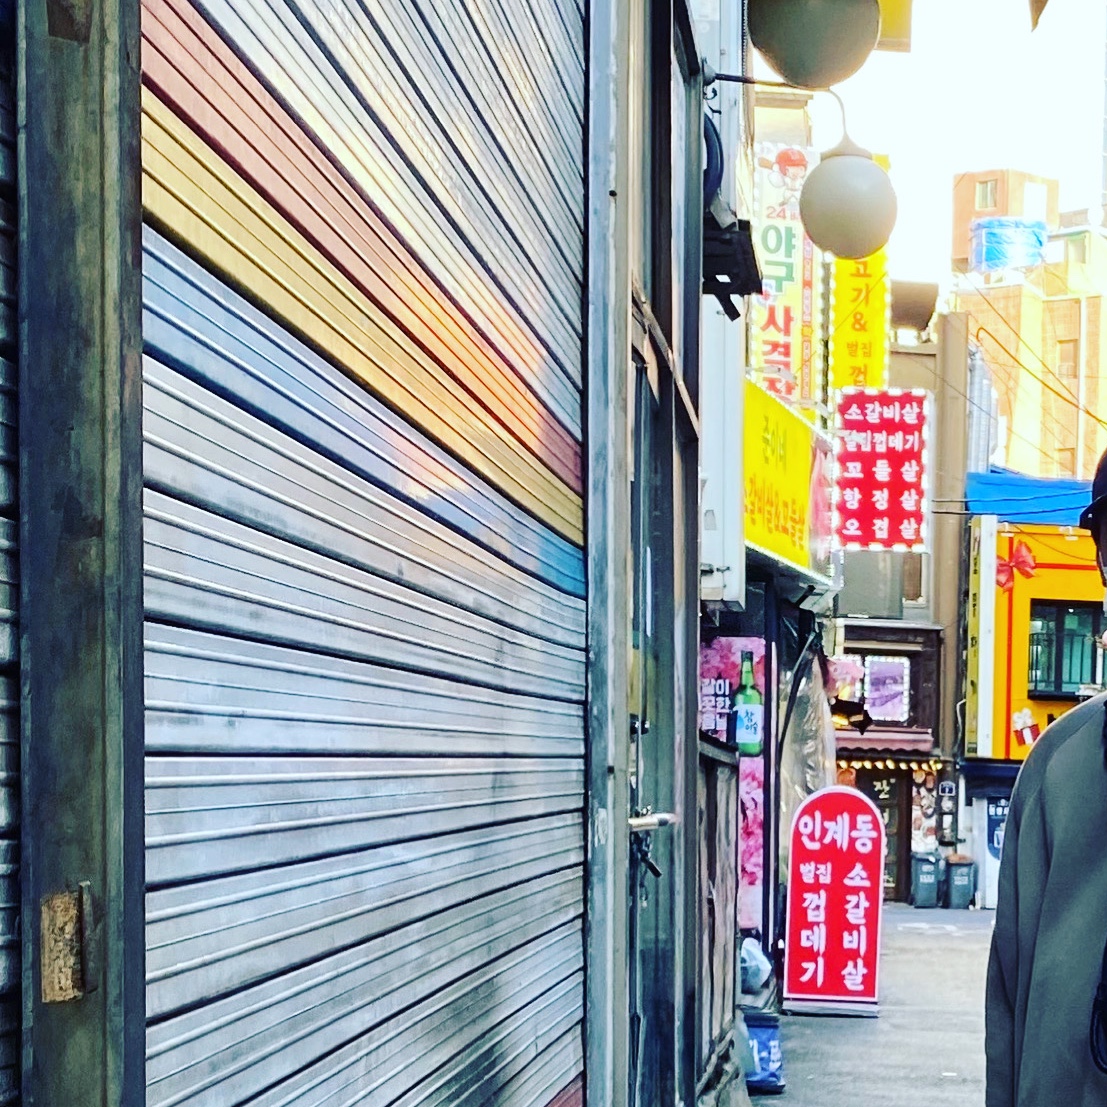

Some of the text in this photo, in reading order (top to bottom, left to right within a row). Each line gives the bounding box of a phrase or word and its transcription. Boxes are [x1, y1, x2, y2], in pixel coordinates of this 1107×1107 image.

[761, 224, 796, 293] 야구
[851, 311, 867, 332] &
[843, 400, 921, 425] 소갈비살
[842, 486, 920, 511] 항정살
[841, 516, 919, 540] 오겹살
[799, 810, 878, 854] 인계동
[799, 861, 832, 988] 벌집 껍데기
[841, 862, 871, 991] 소갈비살
